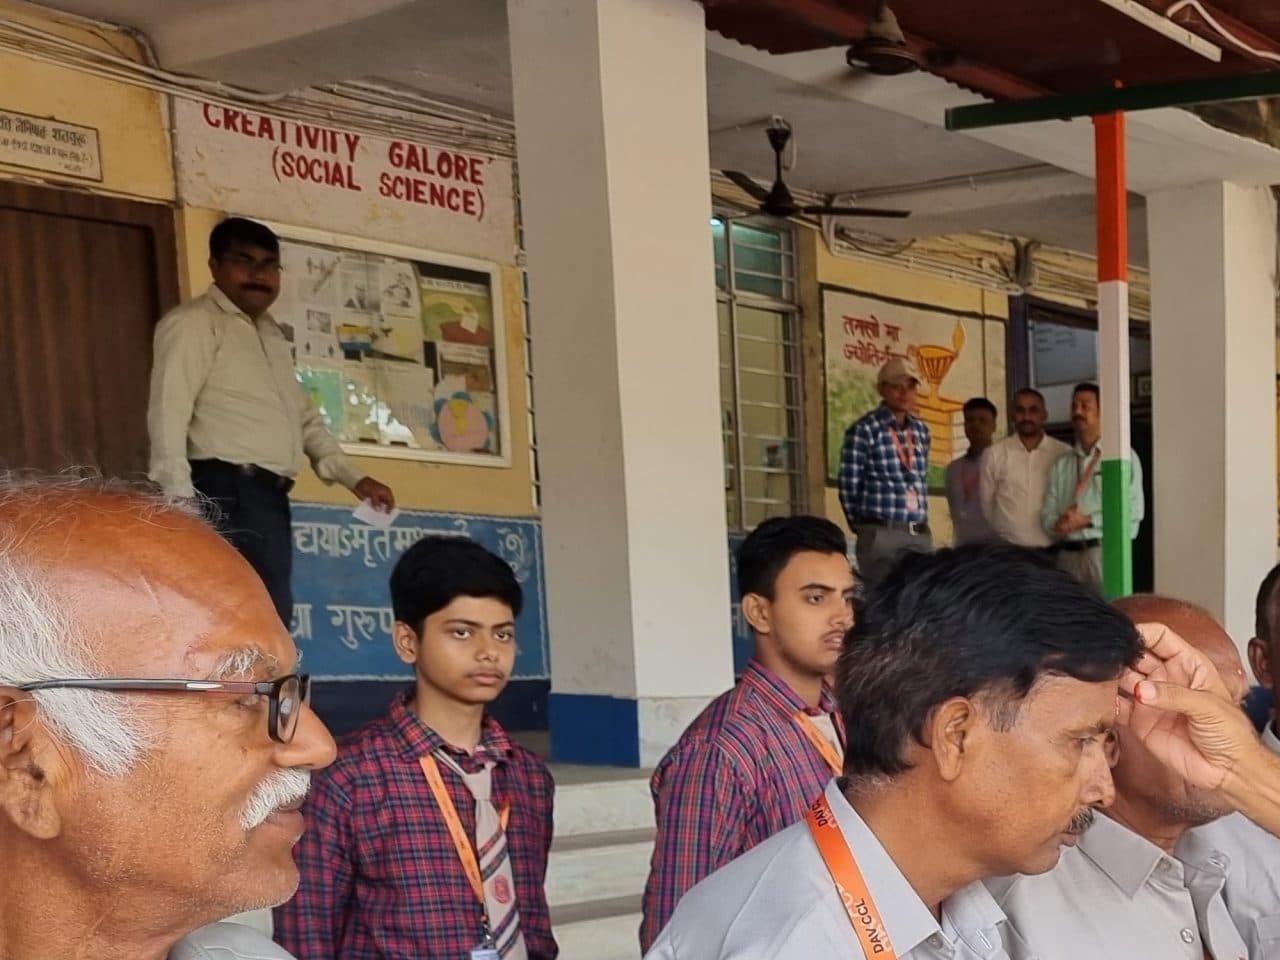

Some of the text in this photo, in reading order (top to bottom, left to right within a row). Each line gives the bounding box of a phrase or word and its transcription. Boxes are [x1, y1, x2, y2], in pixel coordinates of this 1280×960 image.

[203, 102, 485, 186] CREATIVITY GALORE
[271, 146, 485, 222] (SOCIAL SCIENCE)
[855, 897, 884, 954] DAV CCL
